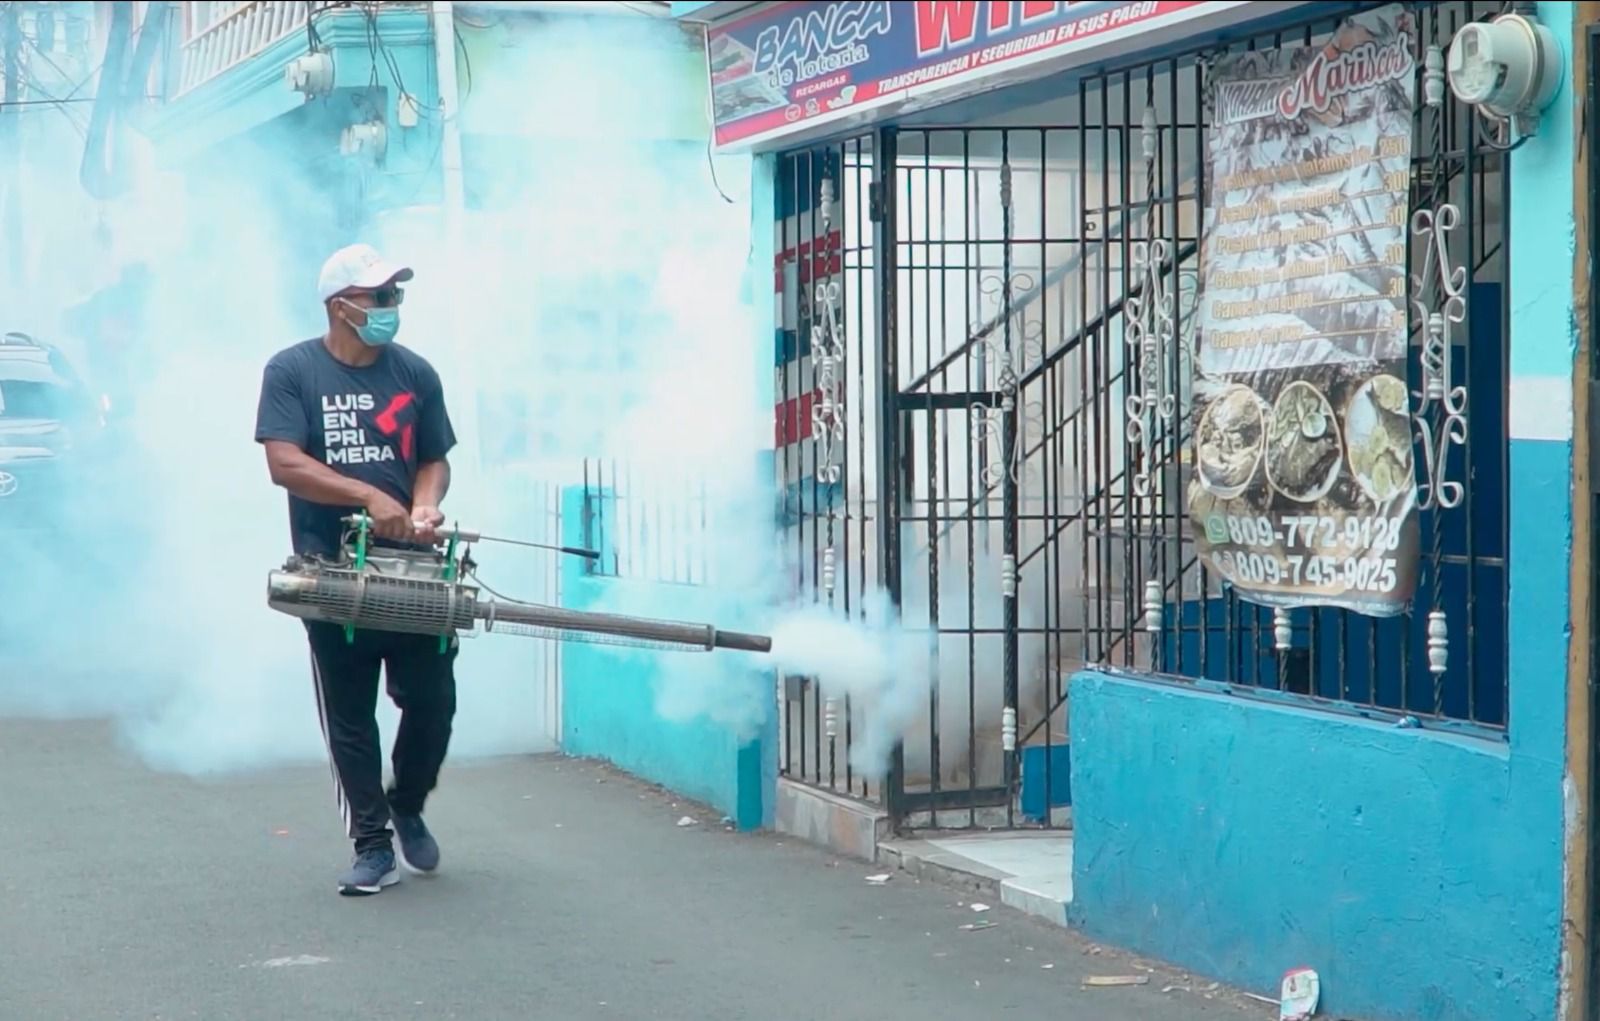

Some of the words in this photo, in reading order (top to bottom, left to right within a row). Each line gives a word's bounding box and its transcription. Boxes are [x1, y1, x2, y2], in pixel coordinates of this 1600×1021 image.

[753, 1, 892, 74] BANCA
[878, 55, 969, 94] TRANSPARENCIA
[971, 50, 981, 67] Y
[980, 27, 1056, 63] SEGURIDAD
[1056, 22, 1077, 41] EN
[1076, 12, 1110, 36] SUS
[769, 64, 793, 88] de
[796, 75, 846, 98] RECARGAS
[1279, 31, 1412, 120] Mariscos
[321, 393, 374, 410] LUIS
[323, 411, 357, 428] EN
[324, 428, 364, 445] PRI
[325, 444, 395, 463] MERA
[1227, 516, 1401, 548] 809-772-9128
[1236, 553, 1396, 591] 809-745-9025
